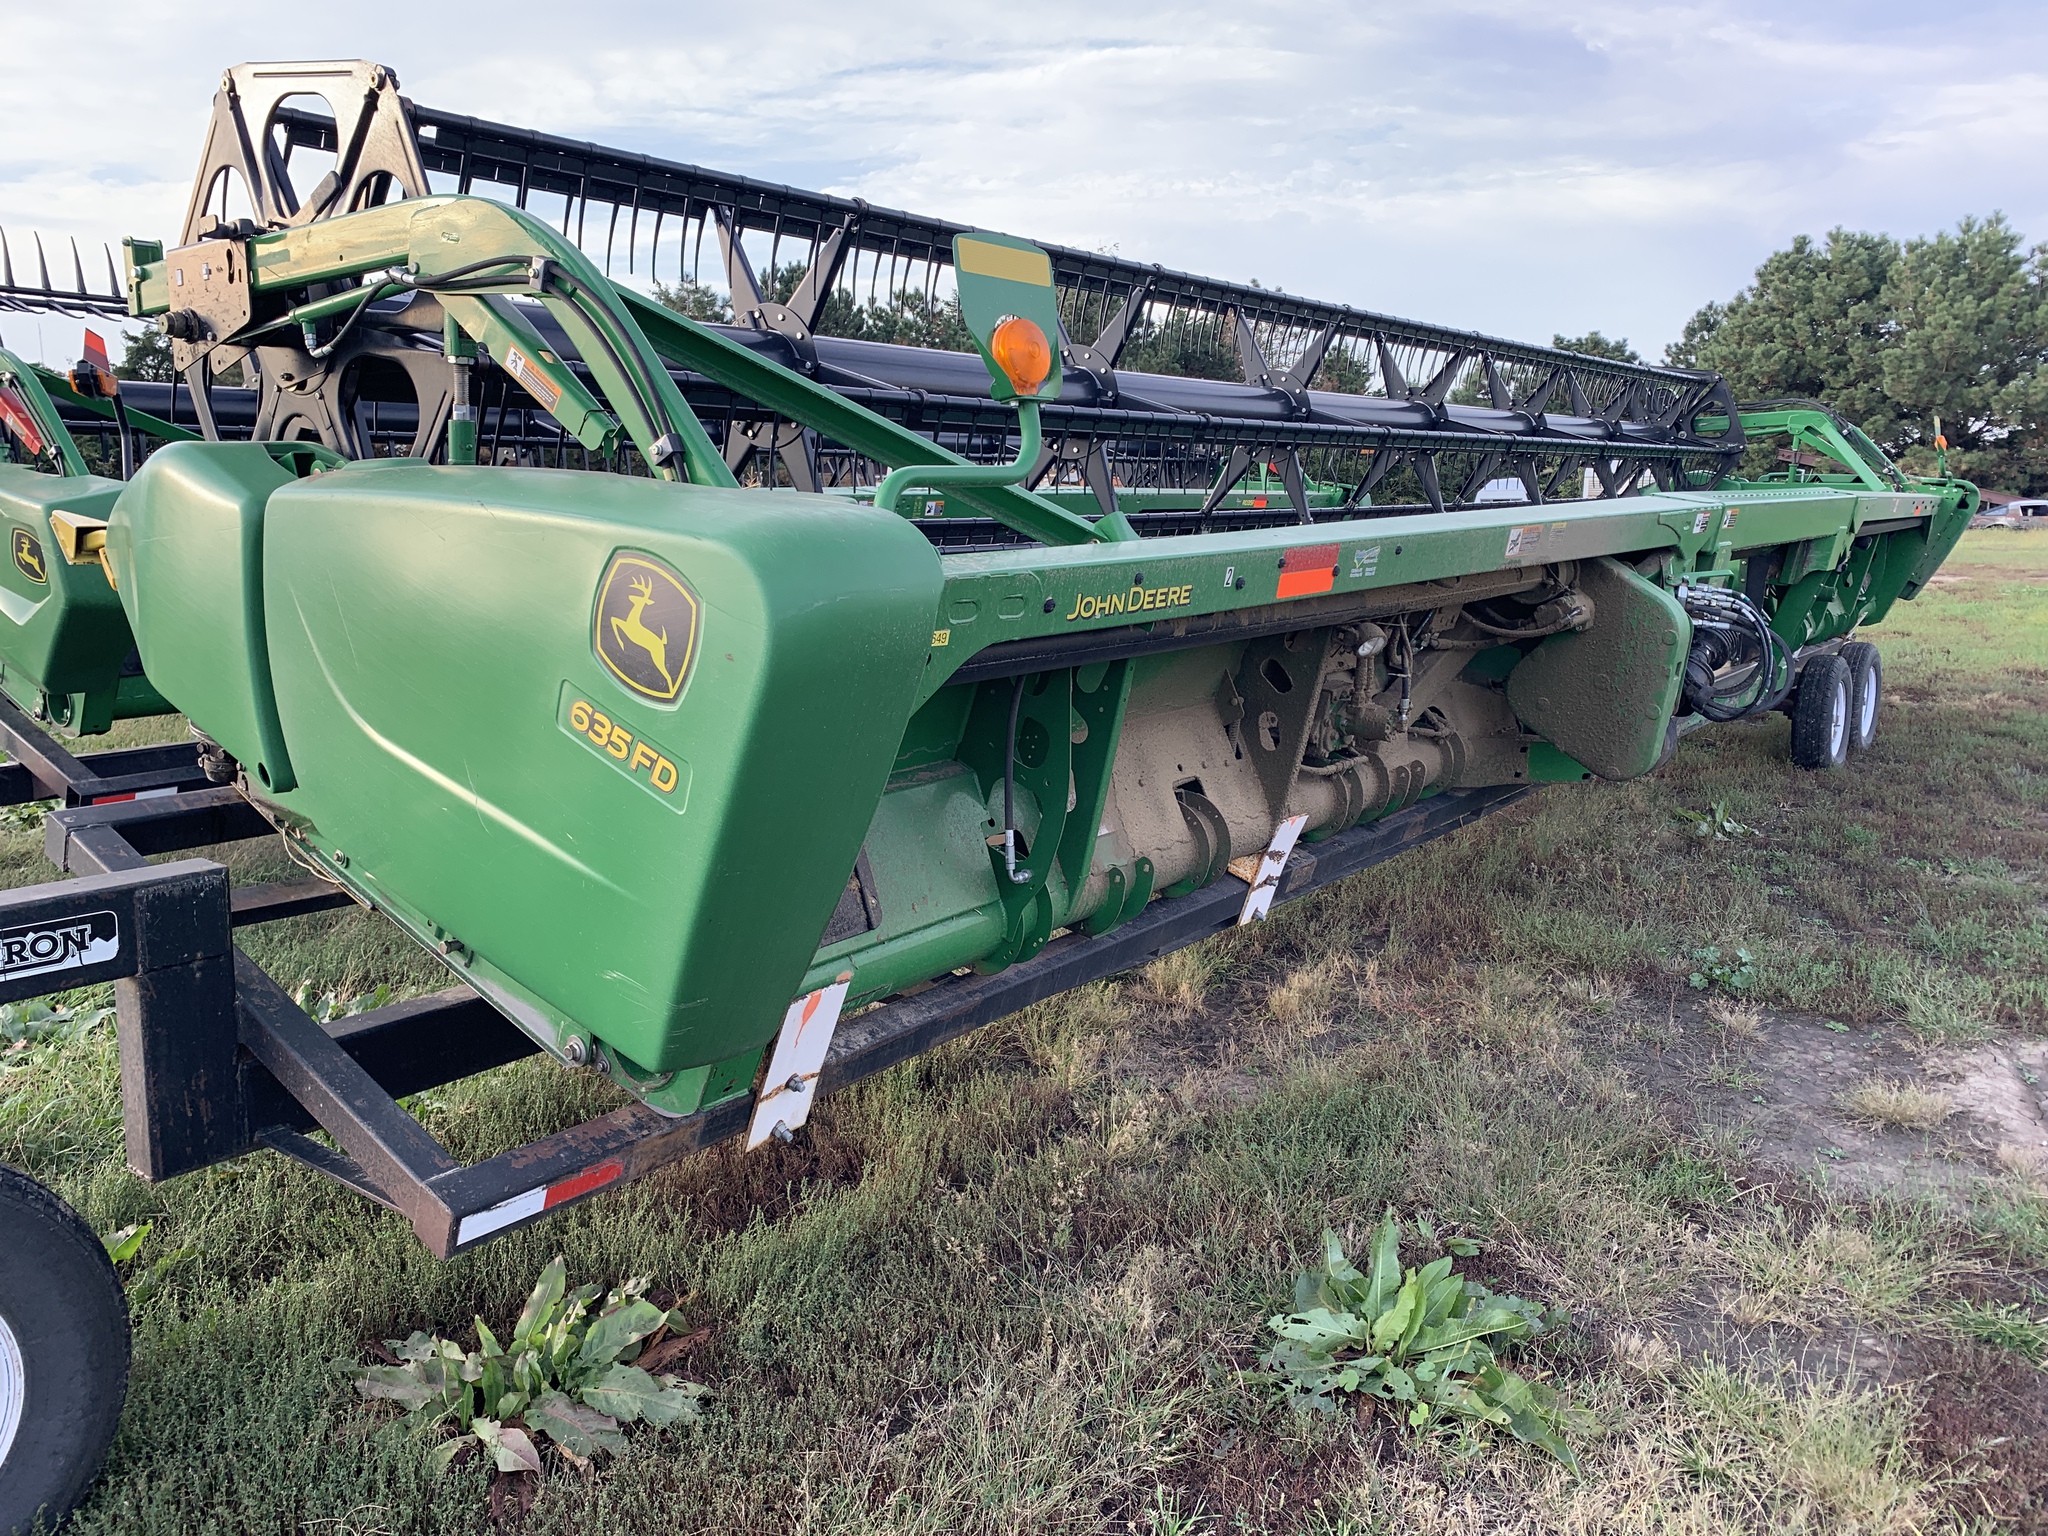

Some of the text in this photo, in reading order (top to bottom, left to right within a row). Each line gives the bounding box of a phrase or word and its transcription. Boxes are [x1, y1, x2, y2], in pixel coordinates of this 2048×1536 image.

[1225, 568, 1233, 586] 2
[1066, 584, 1193, 622] JOHN DEERE
